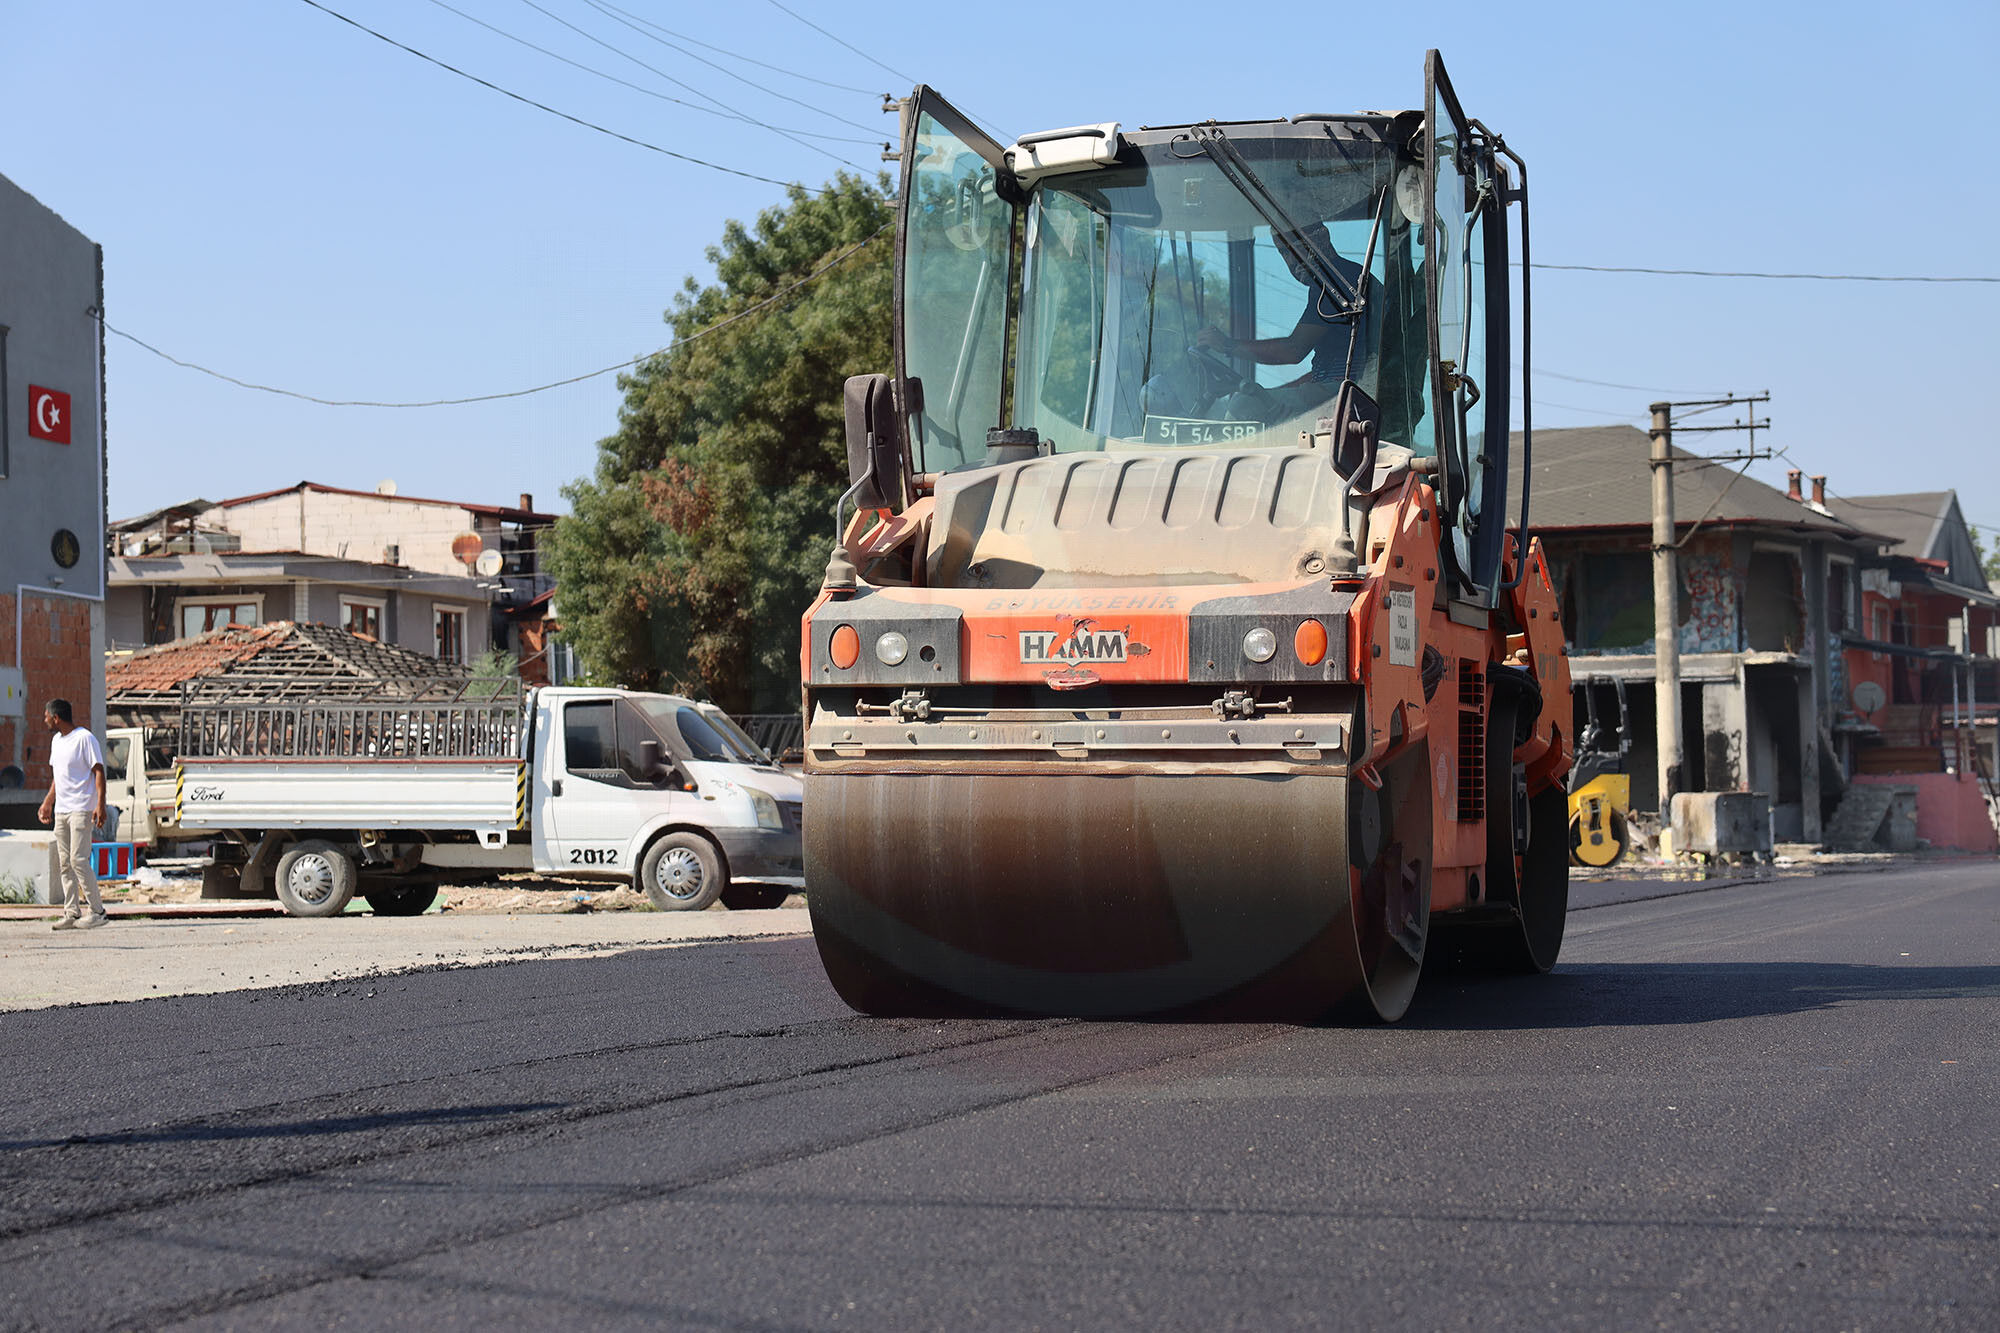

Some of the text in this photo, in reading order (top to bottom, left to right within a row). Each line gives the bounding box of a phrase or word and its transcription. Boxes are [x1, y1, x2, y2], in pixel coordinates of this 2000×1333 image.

[1191, 426, 1213, 443] 54
[1024, 635, 1124, 659] HAMM
[190, 786, 225, 801] Ford
[570, 848, 618, 864] 2012
